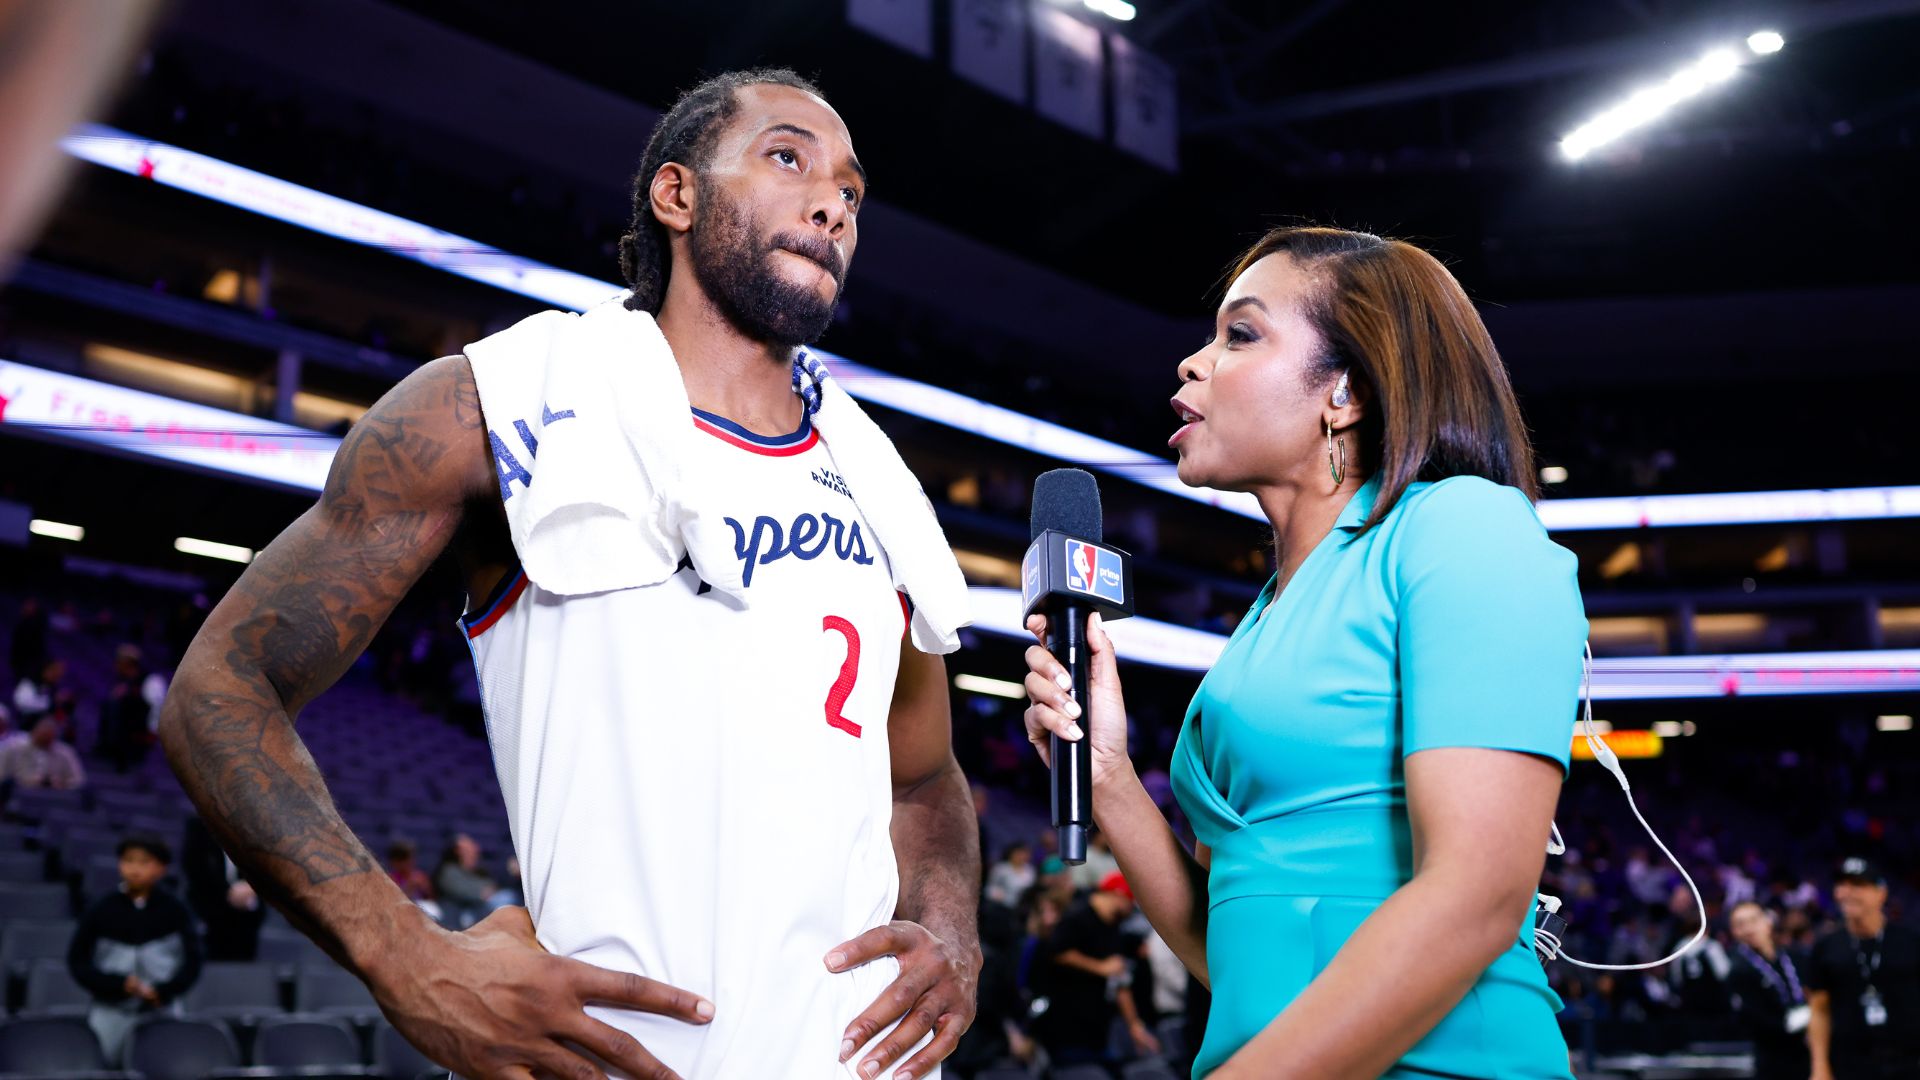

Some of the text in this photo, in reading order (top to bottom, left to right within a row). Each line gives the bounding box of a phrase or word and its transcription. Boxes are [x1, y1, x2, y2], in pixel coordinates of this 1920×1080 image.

[811, 471, 854, 500] RWAN
[1099, 567, 1120, 581] prime
[822, 615, 863, 739] 2
